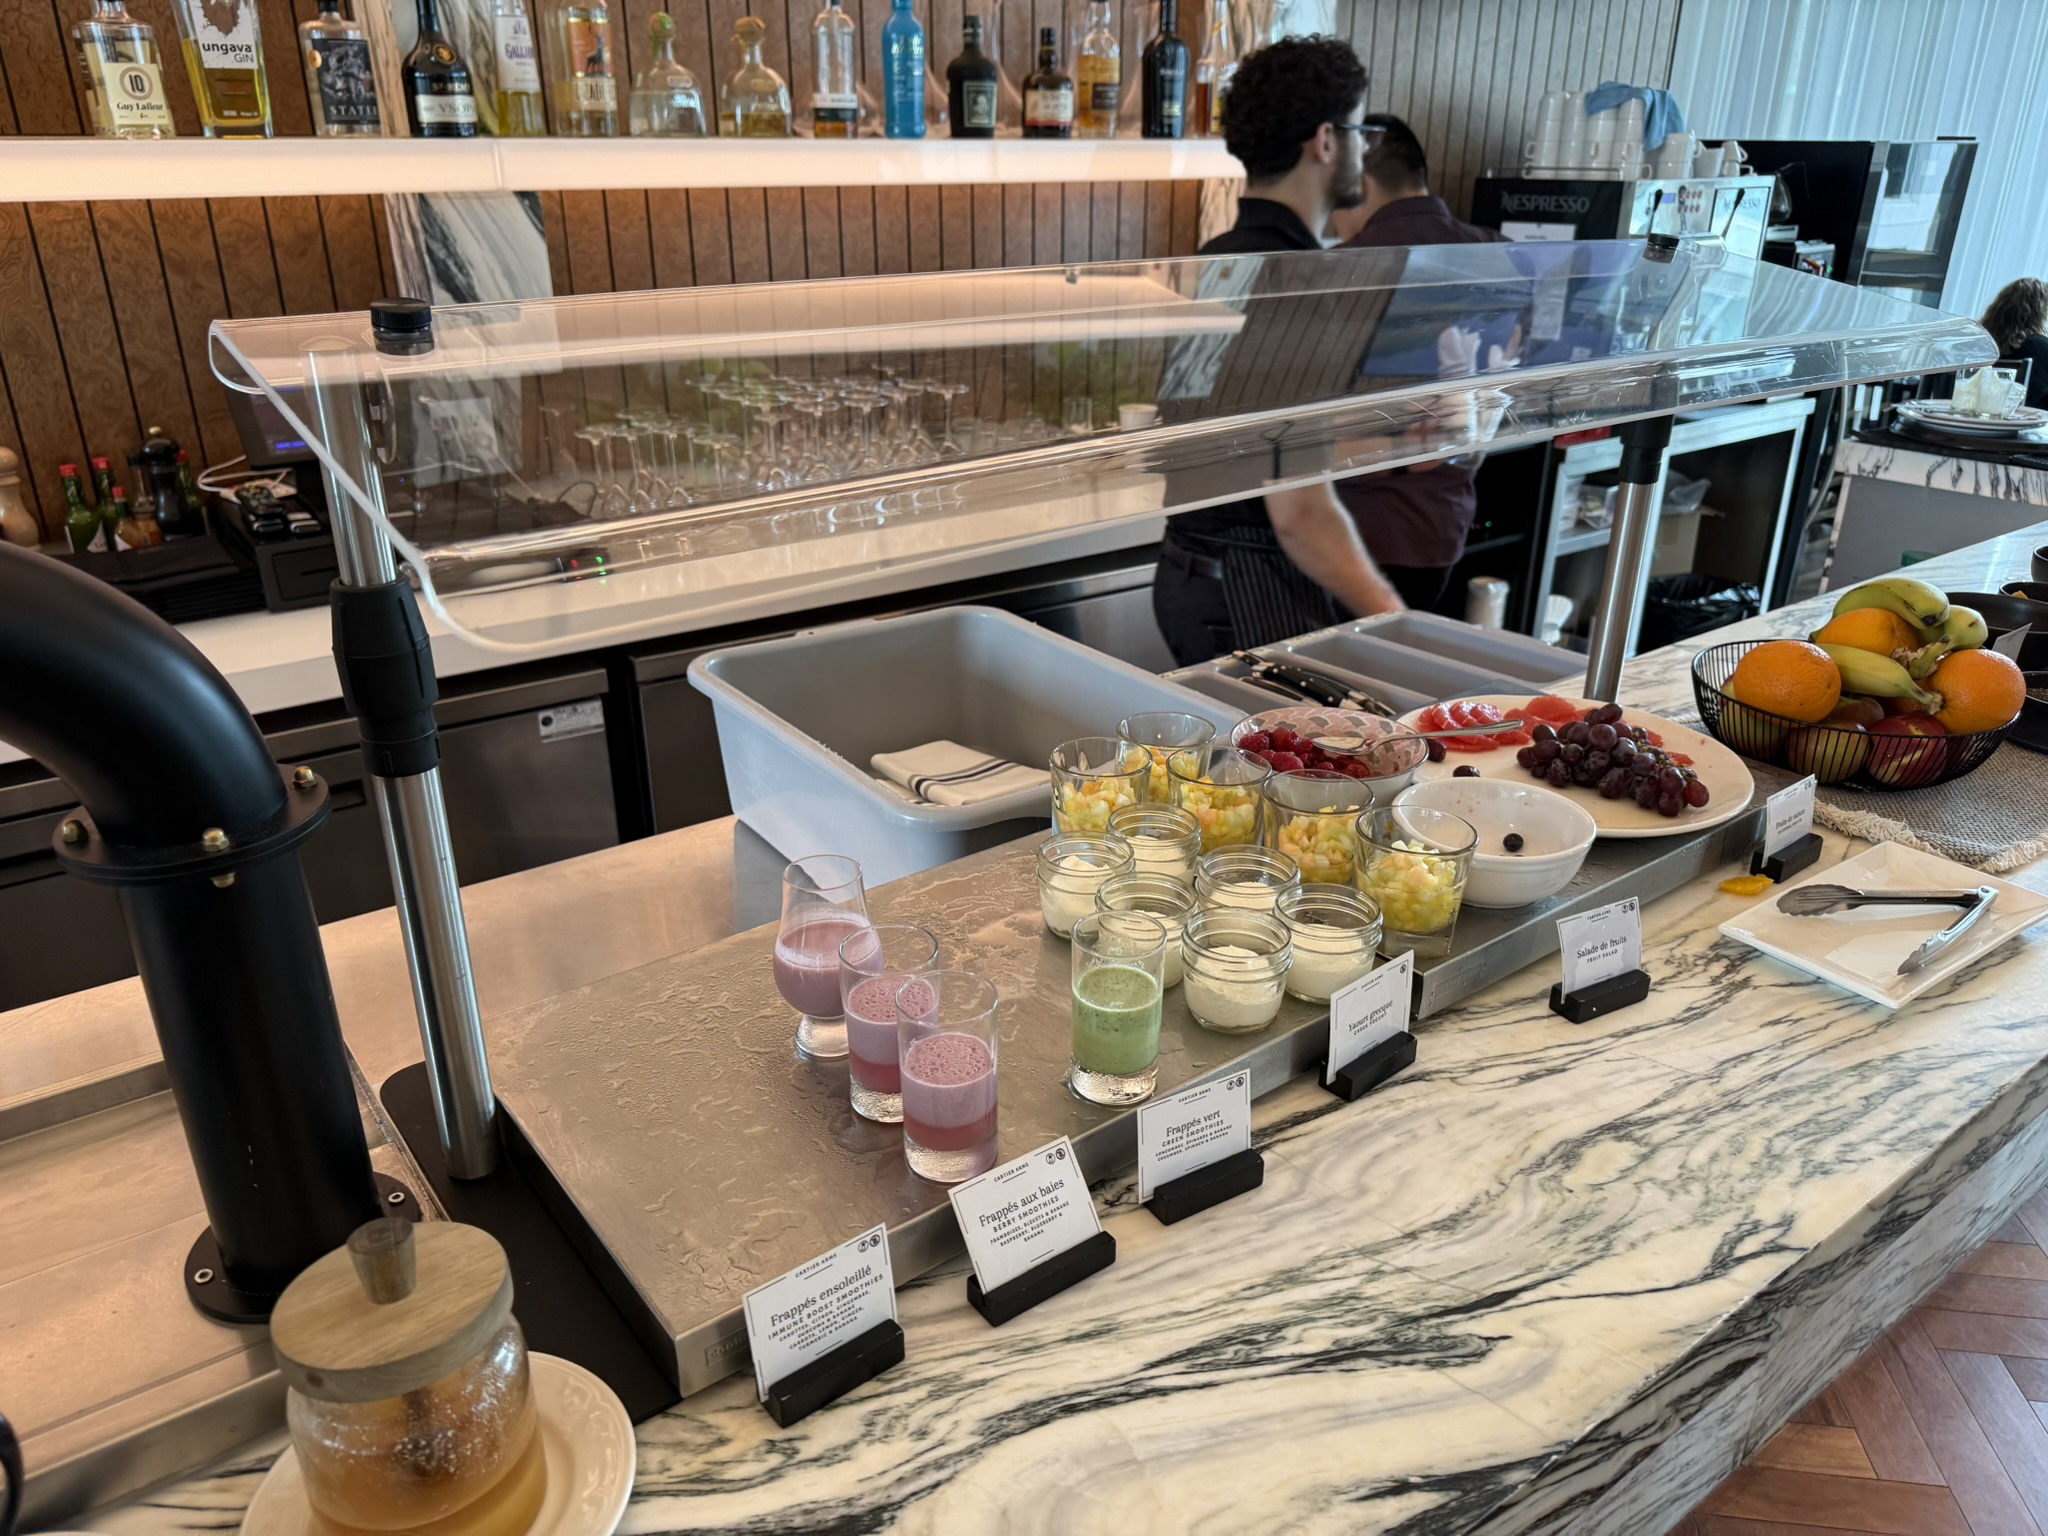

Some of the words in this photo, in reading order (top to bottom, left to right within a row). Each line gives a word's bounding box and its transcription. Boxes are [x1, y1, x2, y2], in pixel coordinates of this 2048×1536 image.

[202, 43, 252, 55] ungava
[234, 53, 254, 63] GIN
[129, 74, 146, 93] 10
[116, 102, 134, 112] Guy
[136, 102, 163, 111] Lafleur
[1500, 190, 1591, 214] NESPRESSO
[1576, 945, 1599, 959] Salade
[1600, 941, 1608, 951] de
[1609, 936, 1627, 948] fruits
[1602, 949, 1618, 958] SALAD
[1161, 1135, 1184, 1147] GREEN
[1186, 1119, 1224, 1138] SMOOTHIES
[1166, 1117, 1202, 1137] Frappés
[1203, 1110, 1221, 1122] vert
[993, 1168, 1015, 1182] CARTIER
[1015, 1162, 1029, 1173] ARMS
[978, 1201, 1019, 1228] Frappés
[1020, 1192, 1039, 1207] aux
[1038, 1179, 1065, 1197] baies
[993, 1216, 1016, 1233] BERRY
[1018, 1195, 1059, 1221] SMOOTHIES
[795, 1261, 820, 1278] CARTIER
[821, 1253, 837, 1265] ARMS
[768, 1316, 804, 1341] IMMUNE
[806, 1300, 833, 1320] BOOST
[836, 1273, 884, 1304] SMOOTHIES
[770, 1296, 817, 1327] Frappés
[819, 1264, 872, 1300] ensoleillé
